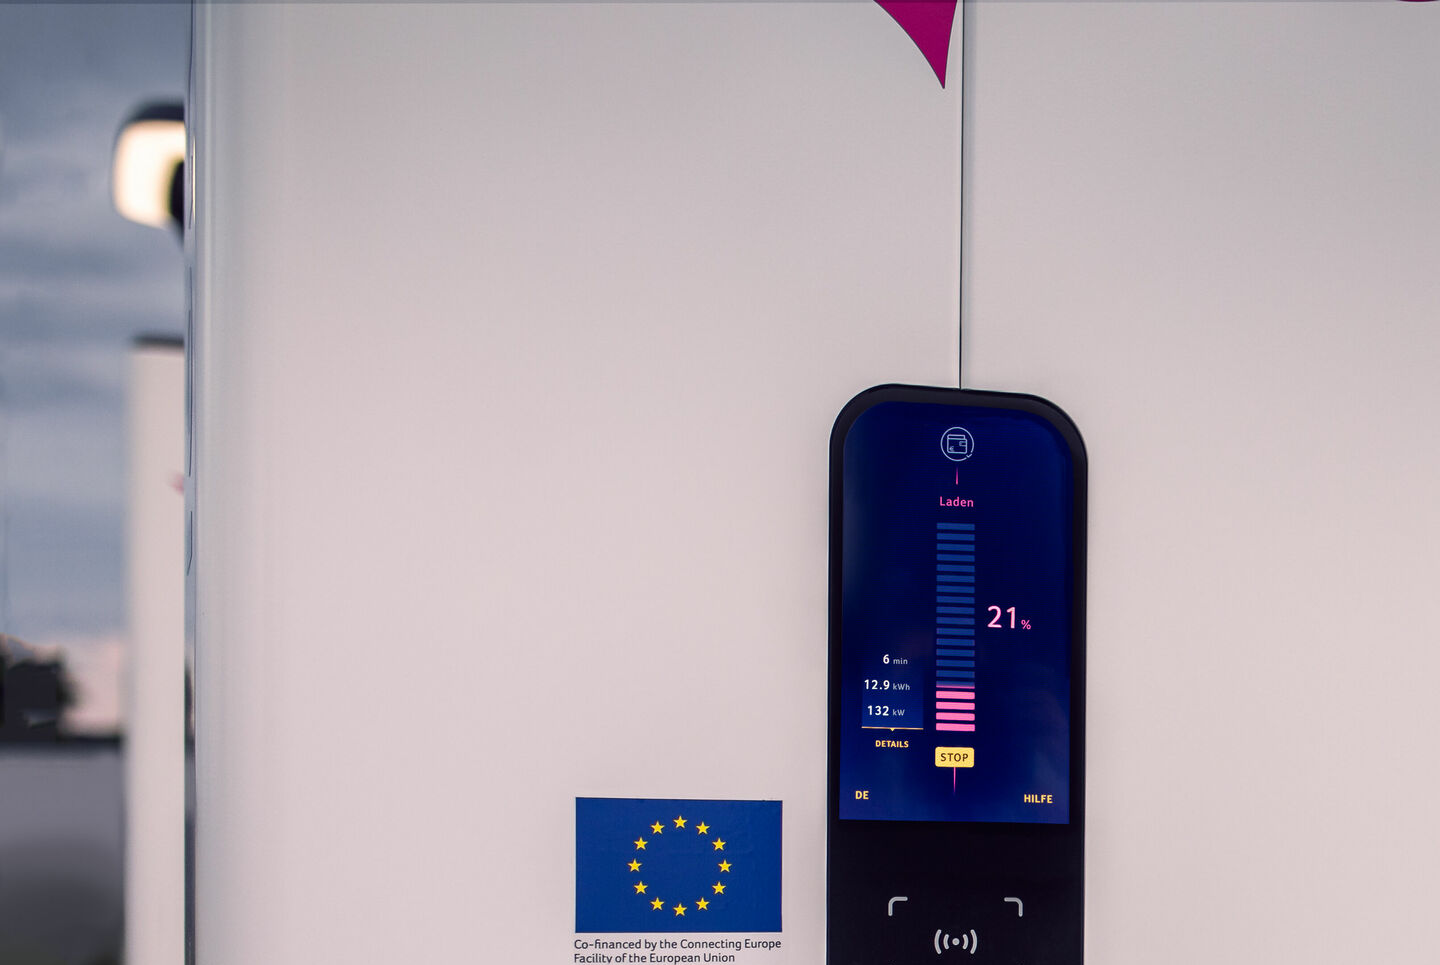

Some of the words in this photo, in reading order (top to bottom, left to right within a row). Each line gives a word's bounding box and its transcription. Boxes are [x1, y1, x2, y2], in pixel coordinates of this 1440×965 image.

[940, 496, 974, 507] Laden
[882, 654, 890, 664] 6
[864, 679, 890, 690] 12.9
[892, 683, 910, 691] kWh
[867, 705, 889, 716] 132
[875, 740, 909, 748] DETAILS
[940, 752, 969, 764] STOP
[855, 790, 869, 800] DE
[1023, 794, 1053, 804] HILFE
[574, 939, 642, 950] Co-financed
[644, 939, 657, 951] by
[659, 939, 677, 949] the
[680, 939, 742, 951] Connecting
[744, 939, 782, 951] Europe
[574, 953, 613, 964] Facility
[615, 953, 627, 963] of
[628, 953, 647, 963] the
[649, 954, 701, 965] European
[703, 954, 735, 963] Union
